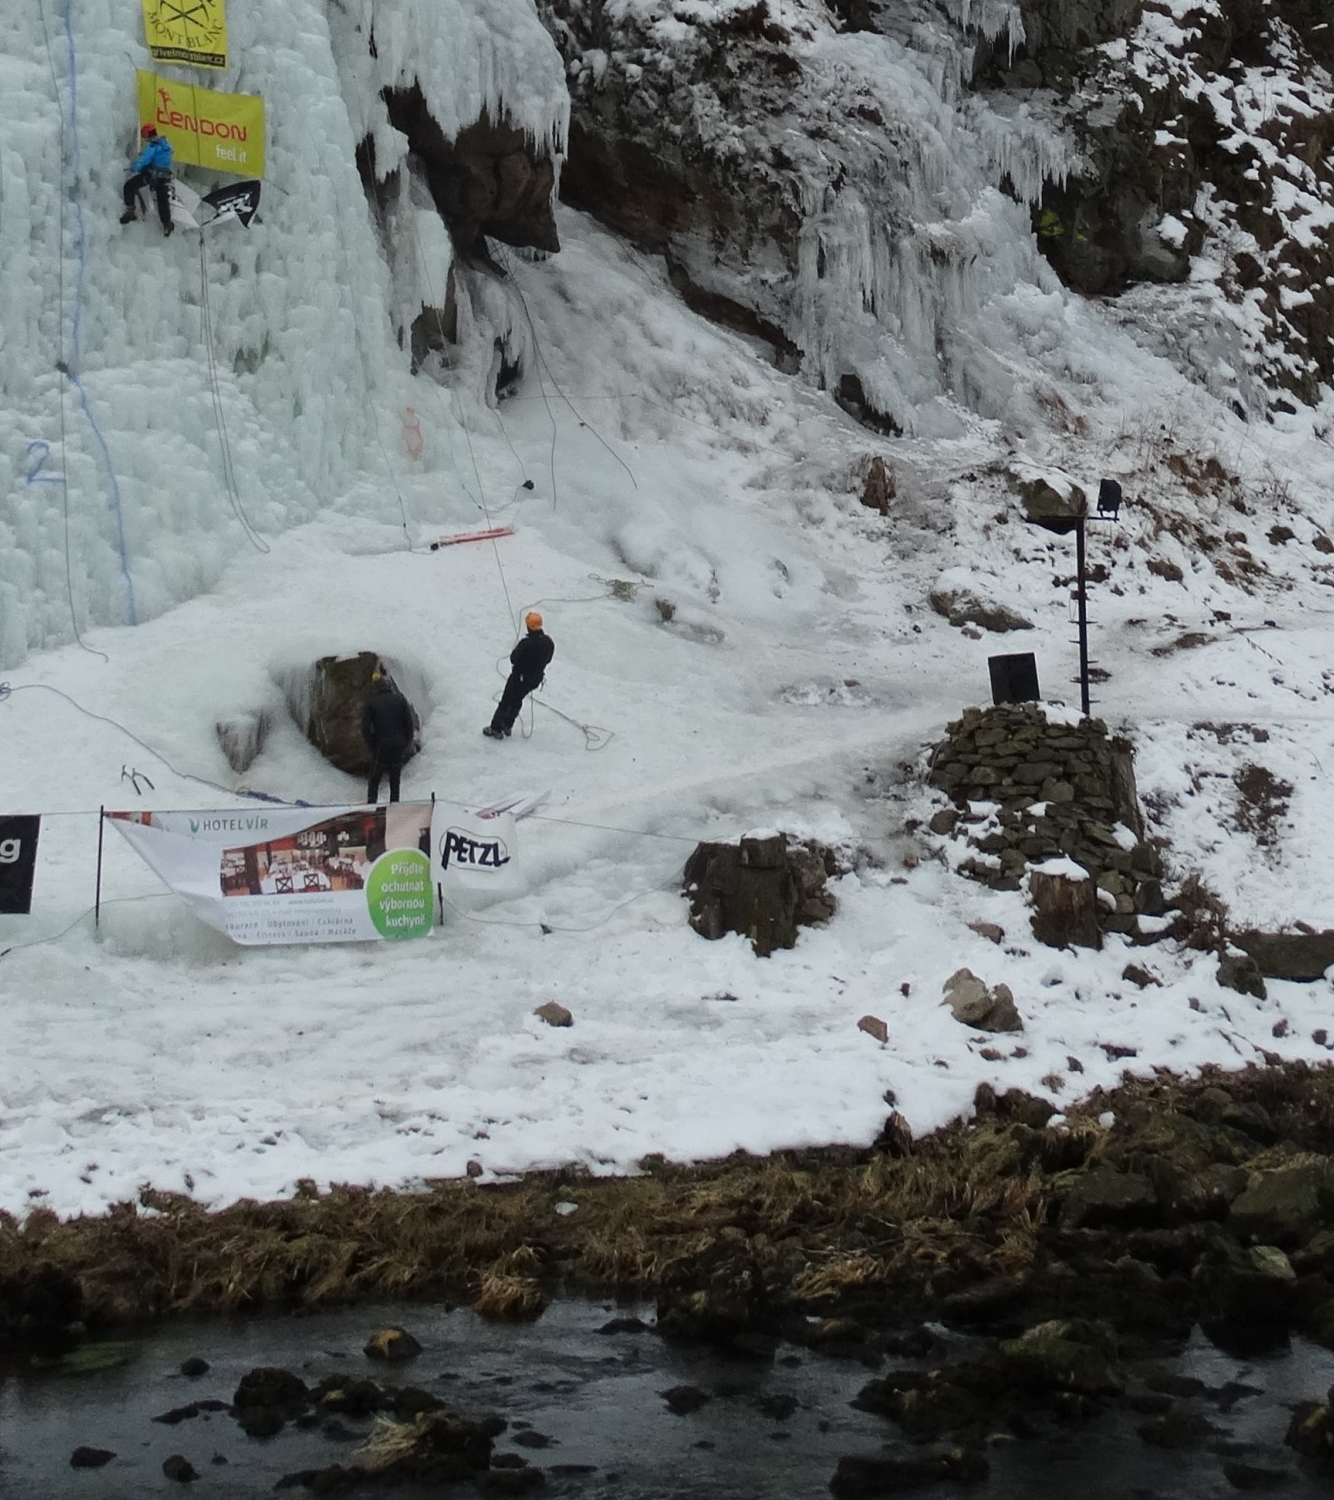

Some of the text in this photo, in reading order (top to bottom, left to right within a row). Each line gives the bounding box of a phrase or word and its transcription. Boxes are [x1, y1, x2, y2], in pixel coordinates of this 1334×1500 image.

[147, 11, 184, 44] MONT
[215, 143, 247, 163] feel it
[203, 815, 269, 831] HOTEL VÍR
[440, 831, 511, 871] PETZL
